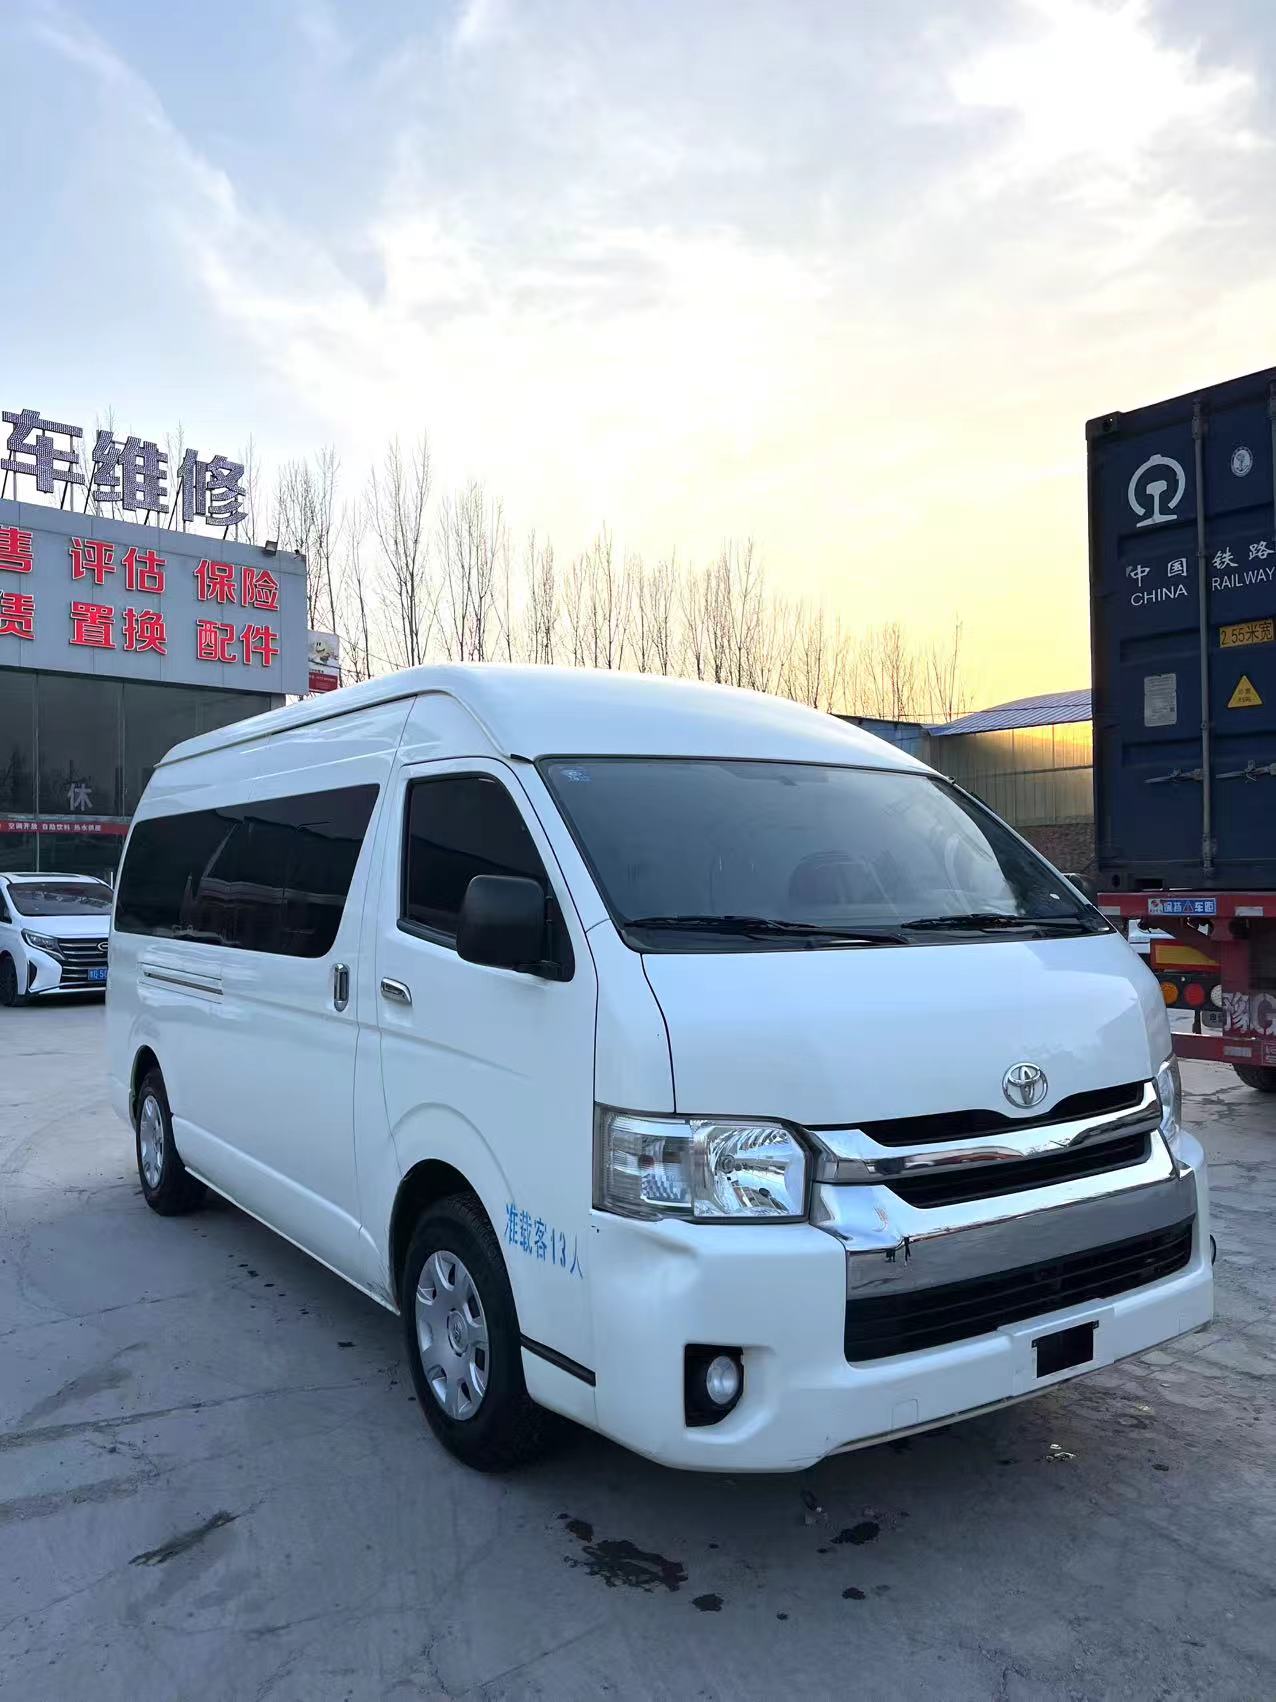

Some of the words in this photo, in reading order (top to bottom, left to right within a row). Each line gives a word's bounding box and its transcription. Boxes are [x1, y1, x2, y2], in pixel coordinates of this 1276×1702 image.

[1, 409, 248, 526] 车维修
[69, 536, 167, 594] 评估
[194, 559, 280, 611] 保险
[1130, 584, 1188, 606] CHINA
[1211, 567, 1276, 591] RAILWAY
[69, 601, 168, 655] 置换
[196, 619, 280, 667] 配件
[67, 783, 94, 812] 休
[504, 1202, 584, 1280] 准载客13人
